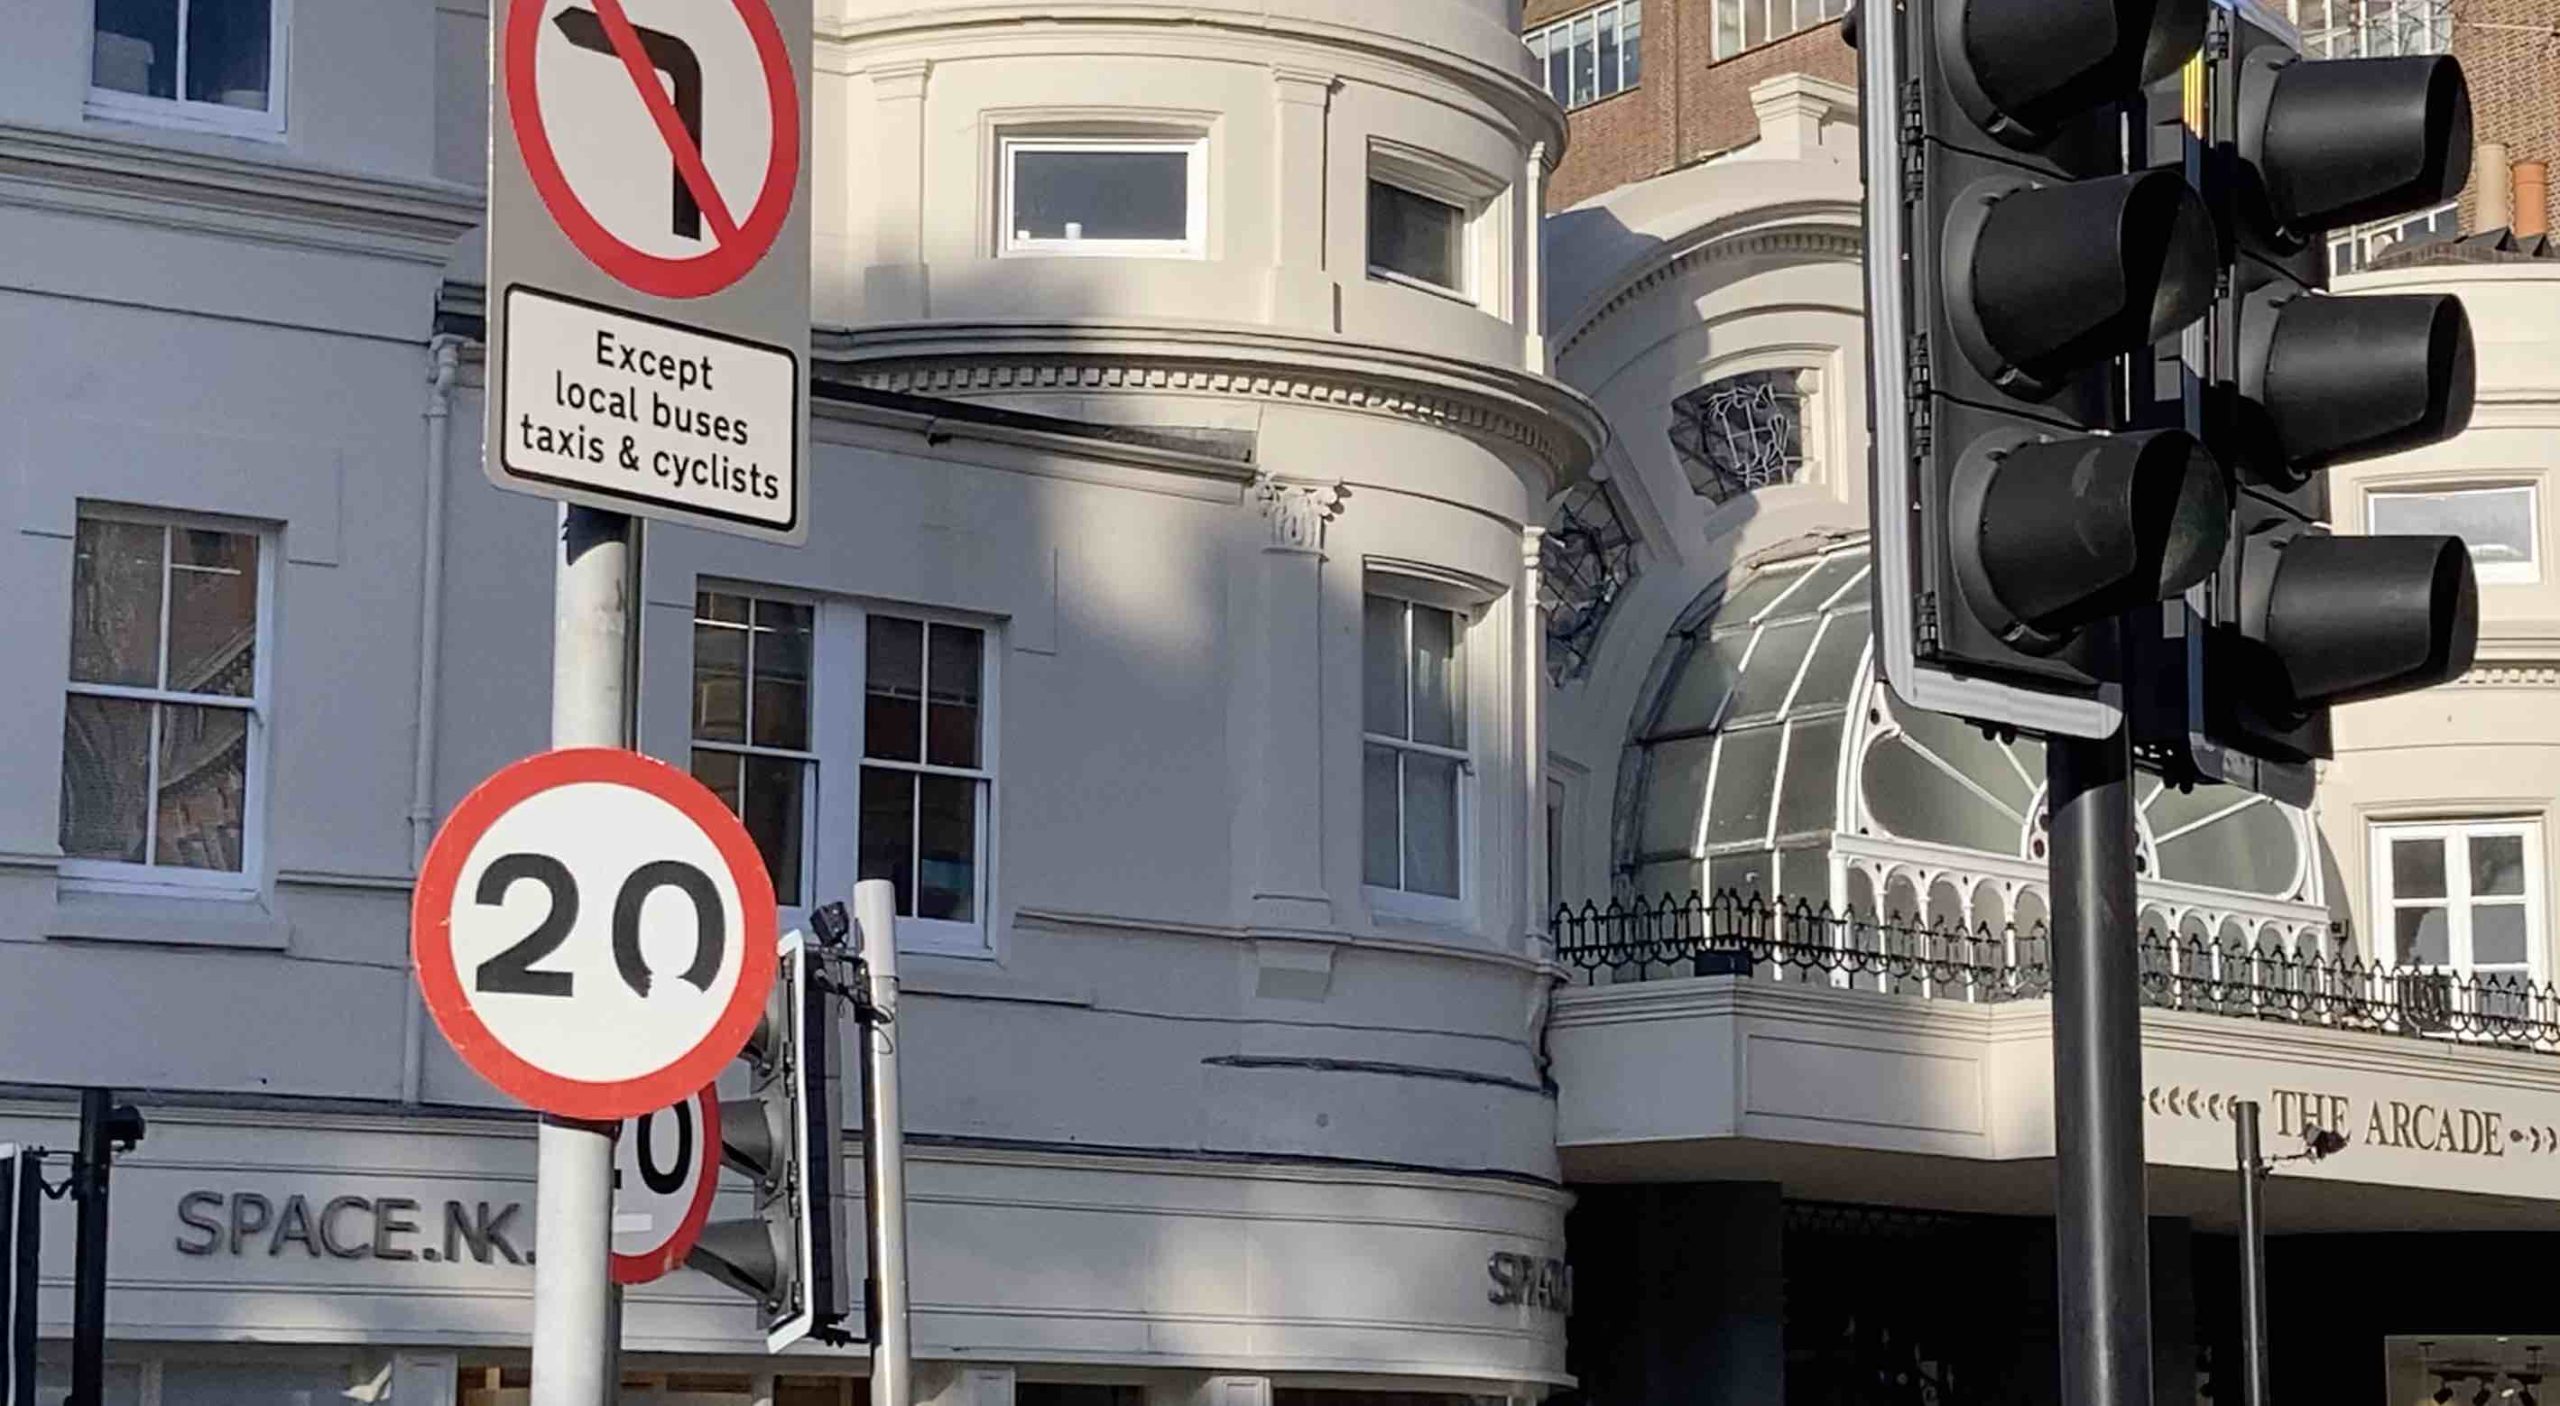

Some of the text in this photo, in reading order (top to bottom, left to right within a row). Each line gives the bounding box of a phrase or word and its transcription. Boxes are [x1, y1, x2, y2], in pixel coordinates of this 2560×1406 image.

[595, 329, 714, 391] Except
[554, 369, 749, 446] local buses
[520, 413, 779, 500] taxis & cyclists
[475, 852, 726, 998] 20
[614, 1098, 692, 1195] 0
[2272, 1089, 2504, 1157] THE ARCADE
